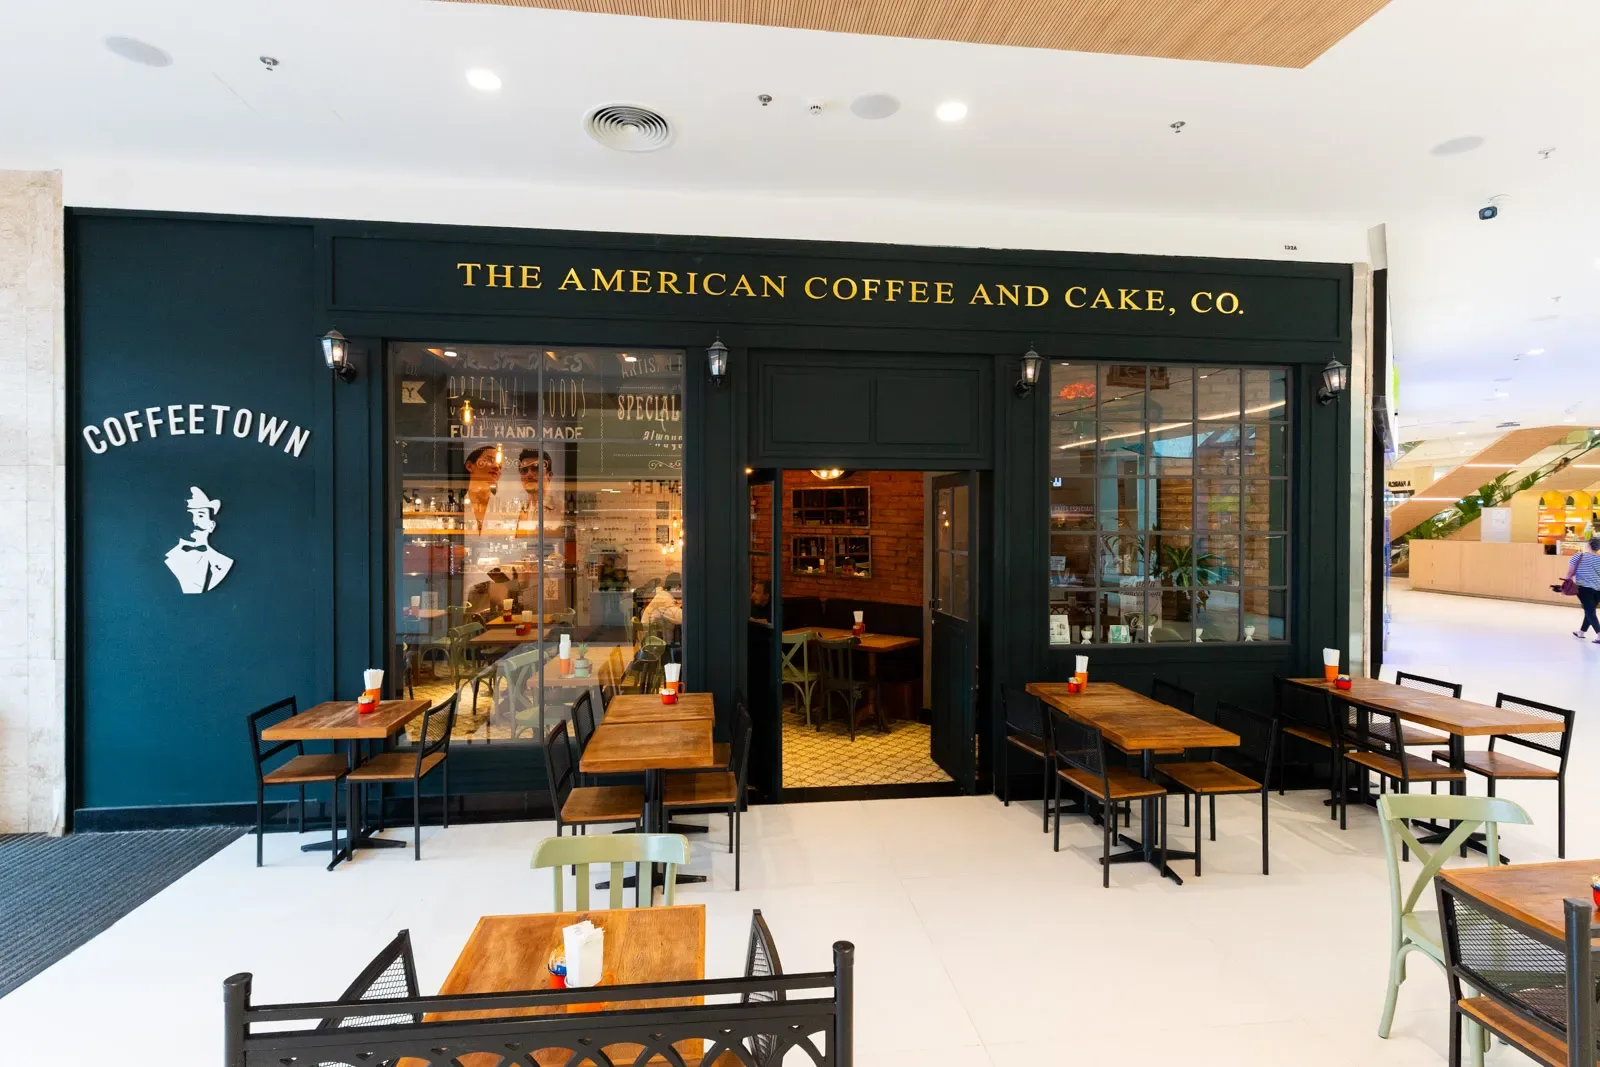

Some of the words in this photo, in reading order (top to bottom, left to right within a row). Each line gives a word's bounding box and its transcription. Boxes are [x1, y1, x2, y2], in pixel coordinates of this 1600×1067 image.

[456, 262, 543, 289] THE
[558, 267, 788, 298] AMERICAN
[804, 276, 956, 304] COFFEE
[968, 283, 1050, 308] AND
[1064, 286, 1177, 316] CAKE,
[1190, 291, 1245, 315] CO.
[617, 394, 680, 421] SPECIAL
[82, 403, 311, 458] COFFEETOWN
[450, 424, 488, 439] FULL
[494, 425, 536, 439] HAND
[543, 426, 585, 440] MADE
